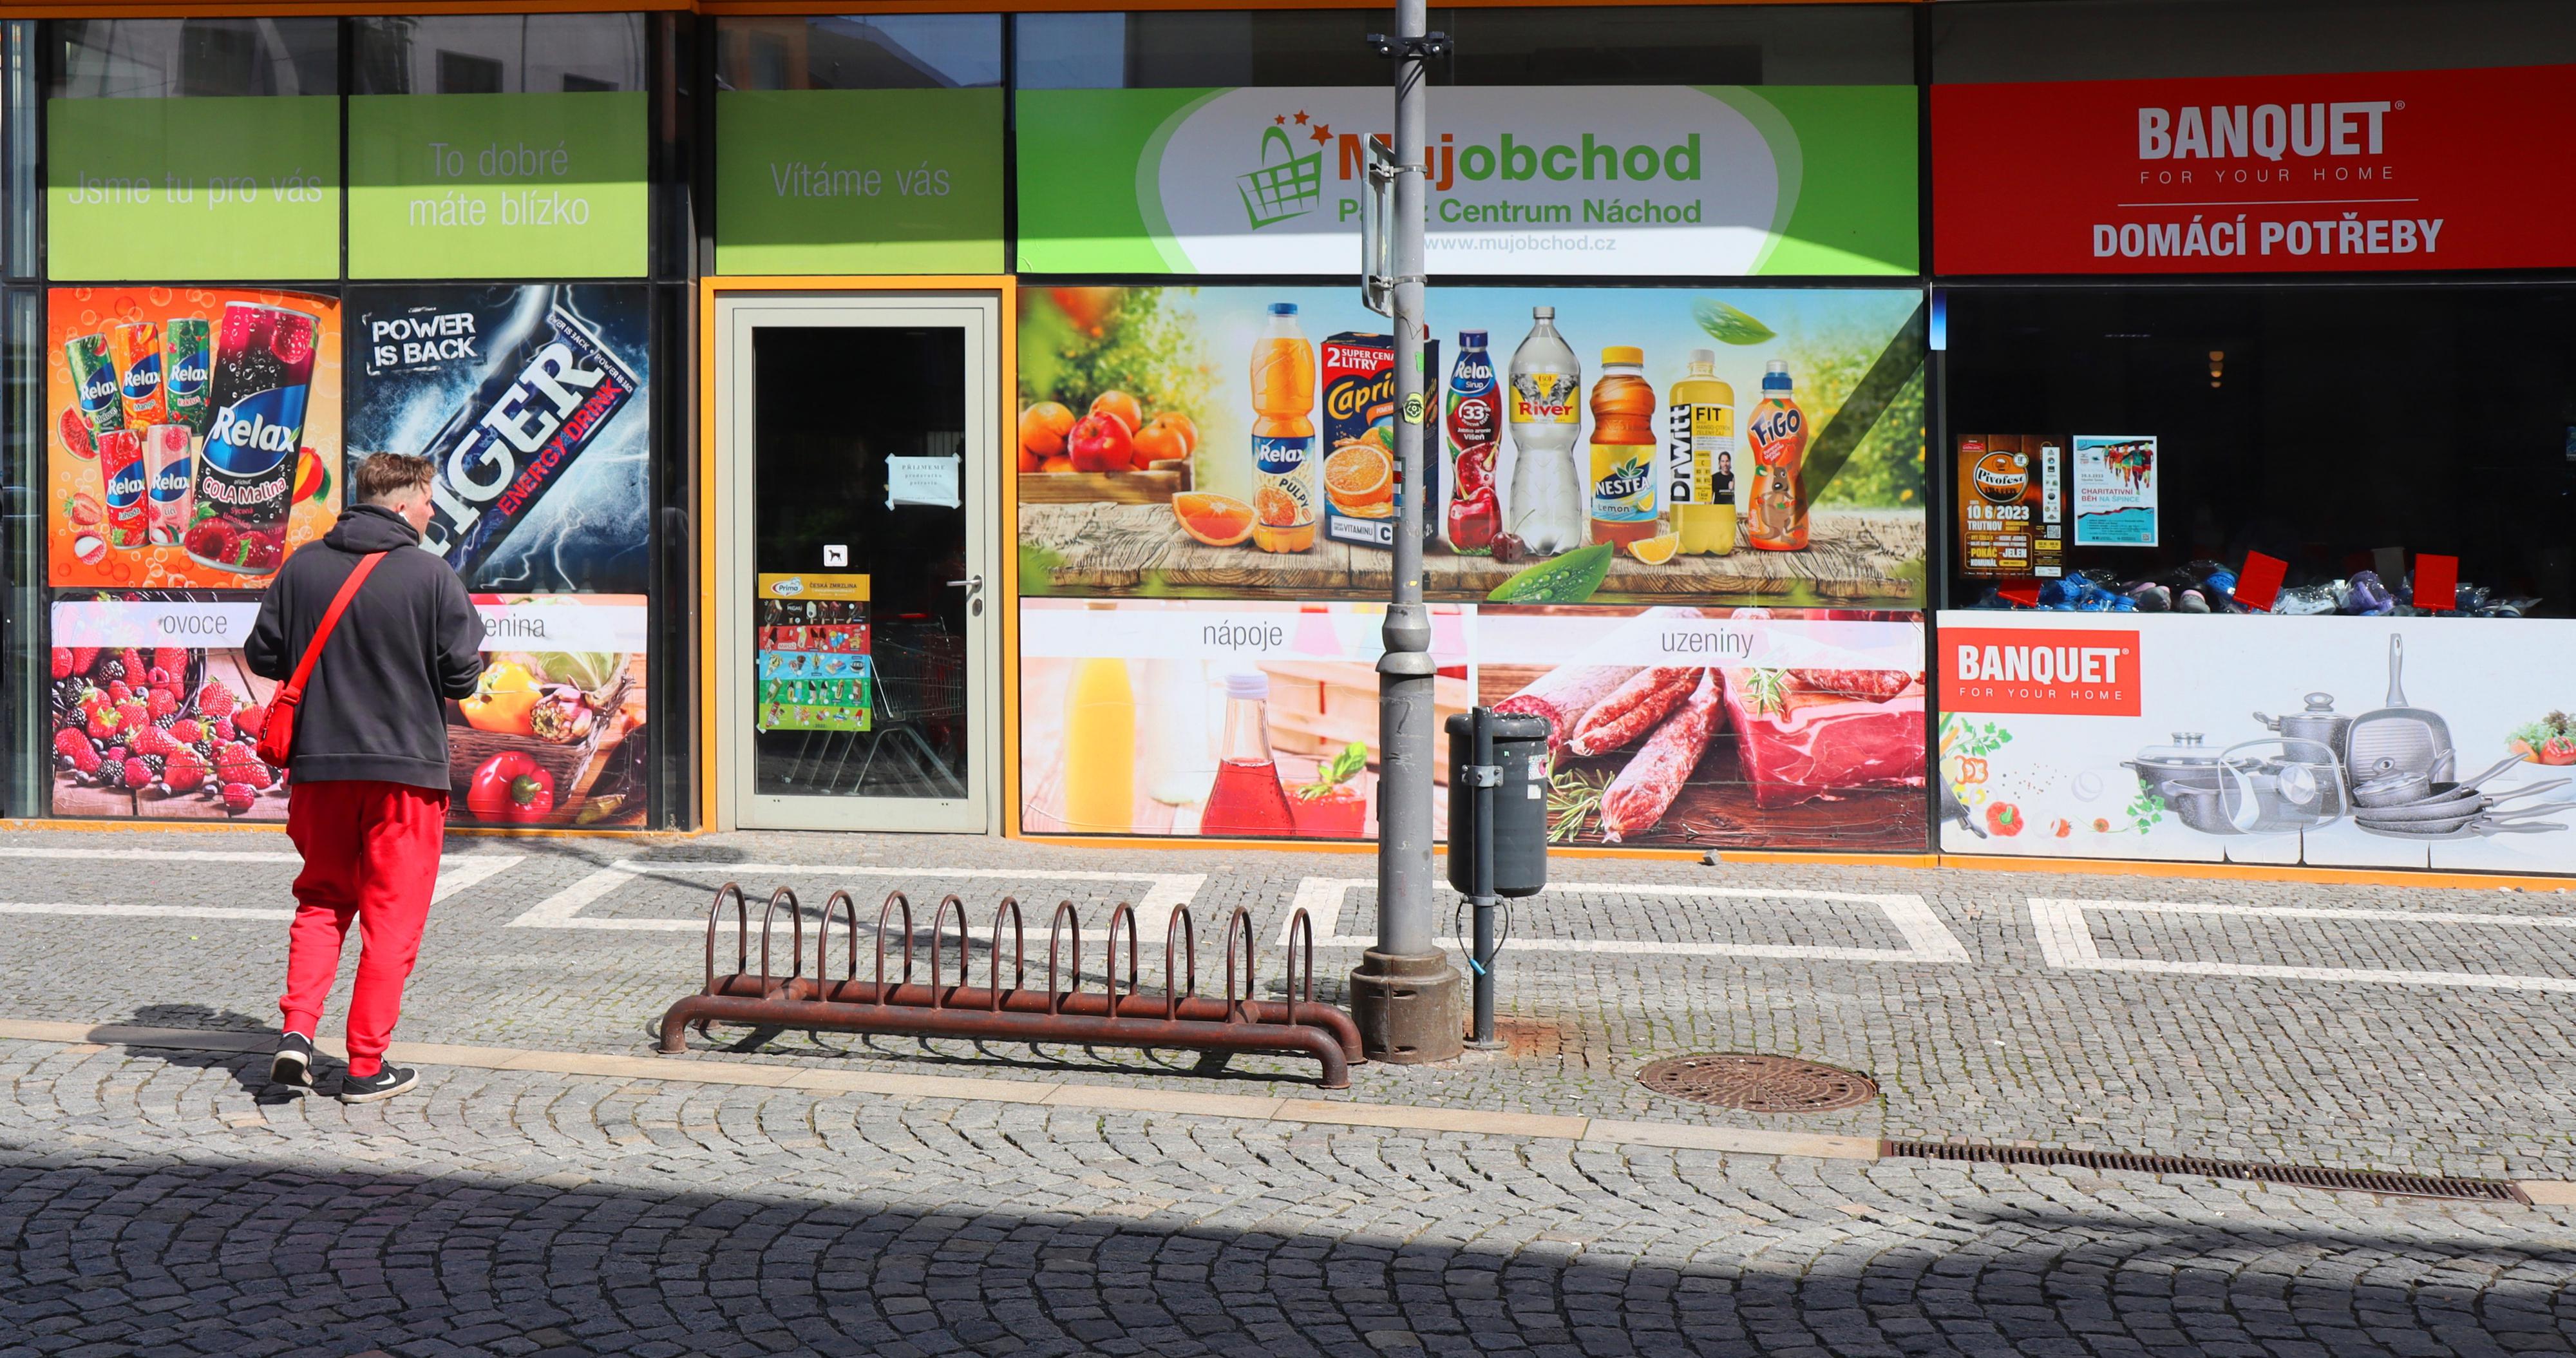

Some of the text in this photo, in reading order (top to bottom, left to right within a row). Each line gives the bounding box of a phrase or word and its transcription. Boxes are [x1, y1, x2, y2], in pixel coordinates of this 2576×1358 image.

[2138, 101, 2391, 162] BANQUET
[428, 140, 568, 177] To dobré
[1339, 133, 1700, 191] Mjobchod
[770, 160, 951, 197] Vítáme vás
[2140, 166, 2393, 184] FOR YOUR HOME
[68, 167, 323, 211] Jsme tu pro vás
[409, 189, 590, 227] máte blízko
[1439, 198, 1571, 223] Centrum
[1584, 198, 1701, 223] Náchod
[1425, 234, 1616, 253] www.mujobchod.cz
[2093, 212, 2444, 258] DOMÁCÍ POTŘEBY
[372, 312, 477, 343] POWER
[374, 336, 478, 367] IS BACK
[1327, 347, 1340, 367] 2
[1341, 349, 1370, 359] SUPER
[171, 365, 208, 382] Relax
[594, 353, 619, 378] POWER
[1341, 358, 1378, 371] LITRY
[1455, 361, 1493, 379] Relax
[124, 369, 161, 387] Relax
[81, 381, 117, 400] Relax
[133, 399, 156, 412] Mango
[177, 396, 201, 406] Kaktus
[1519, 401, 1573, 417] River
[1696, 407, 1721, 421] FIT
[212, 406, 295, 453] Relax
[497, 378, 624, 516] ENERGY DRINK
[1260, 443, 1307, 463] Relax
[108, 477, 145, 495] Relax
[153, 473, 190, 490] Relax
[1596, 476, 1651, 497] NESTEA
[1978, 468, 2023, 485] Pivofest
[202, 476, 287, 504] COLA Malina
[1278, 478, 1309, 508] PULPY
[1598, 503, 1630, 513] Lemon
[1967, 505, 2030, 520] 10/6/2023
[1343, 523, 1373, 536] VITAMINU
[1967, 520, 2003, 531] TRUTNOV
[1971, 546, 1998, 558] POKÁČ
[2003, 548, 2027, 558] JELEN
[779, 584, 799, 592] Prima
[164, 615, 227, 635] ovoce
[1204, 619, 1283, 652] nápoje
[1662, 627, 1754, 659] uzeniny
[1958, 645, 2121, 685] BANQUET
[1959, 687, 2123, 701] FOR YOUR HOME
